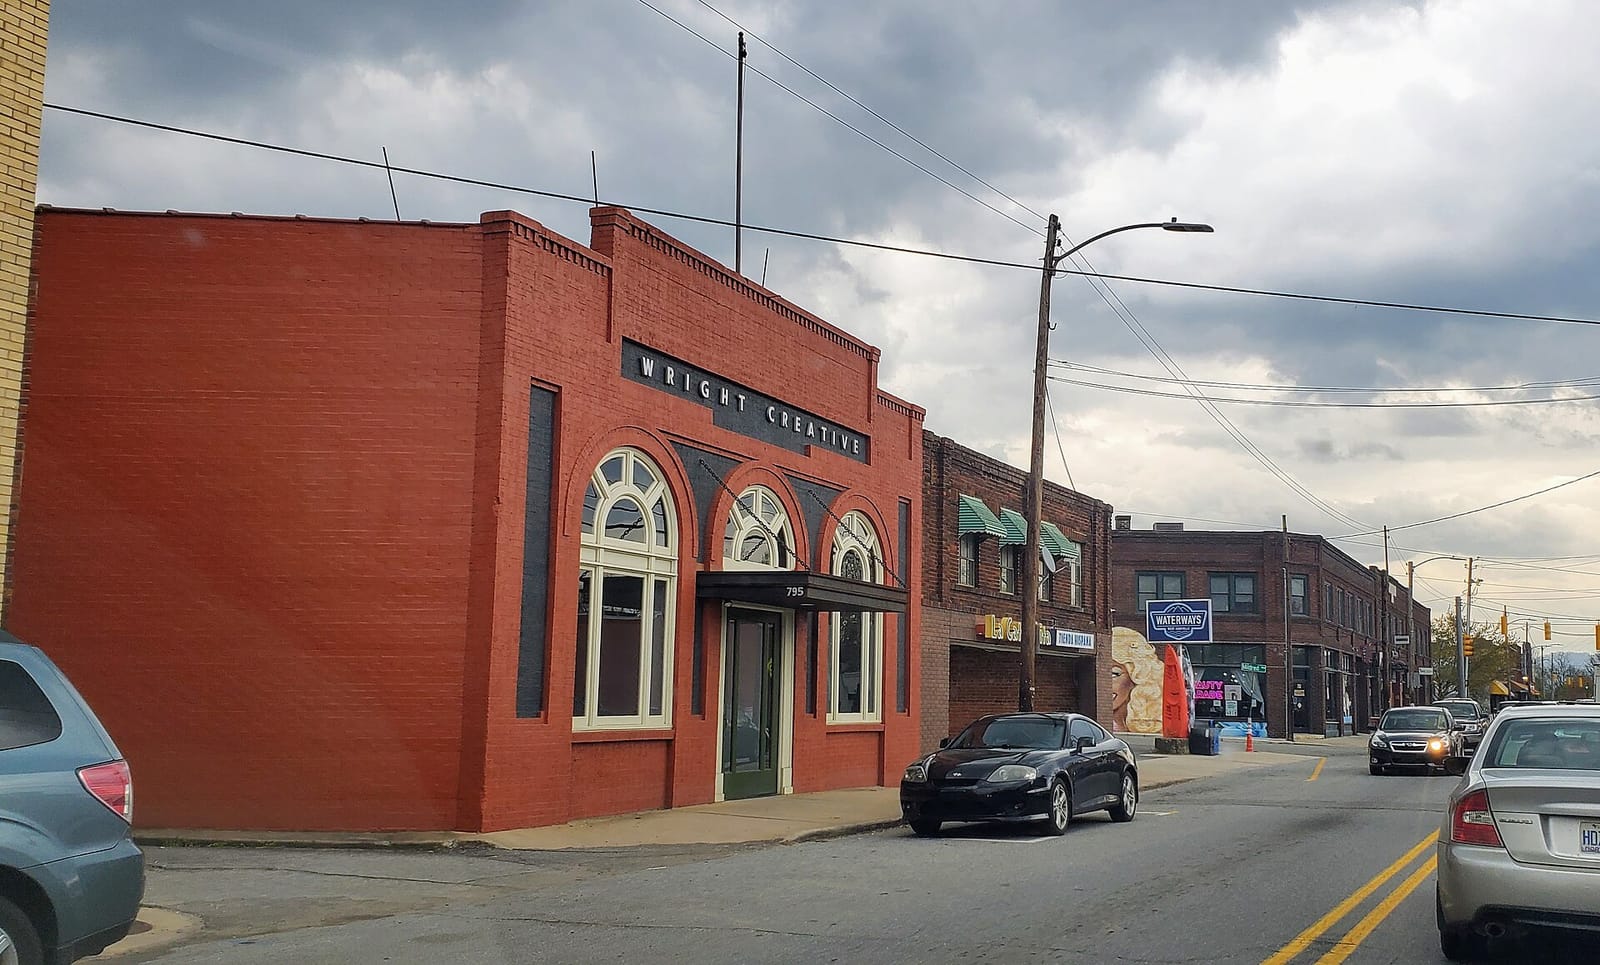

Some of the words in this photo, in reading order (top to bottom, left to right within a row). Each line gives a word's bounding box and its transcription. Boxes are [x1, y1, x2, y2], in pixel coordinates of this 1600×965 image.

[641, 356, 746, 412] WRIGHT
[766, 406, 860, 455] CREATIVE
[786, 587, 804, 597] 795
[990, 614, 1004, 640] La
[1156, 615, 1202, 625] WATERWAYS
